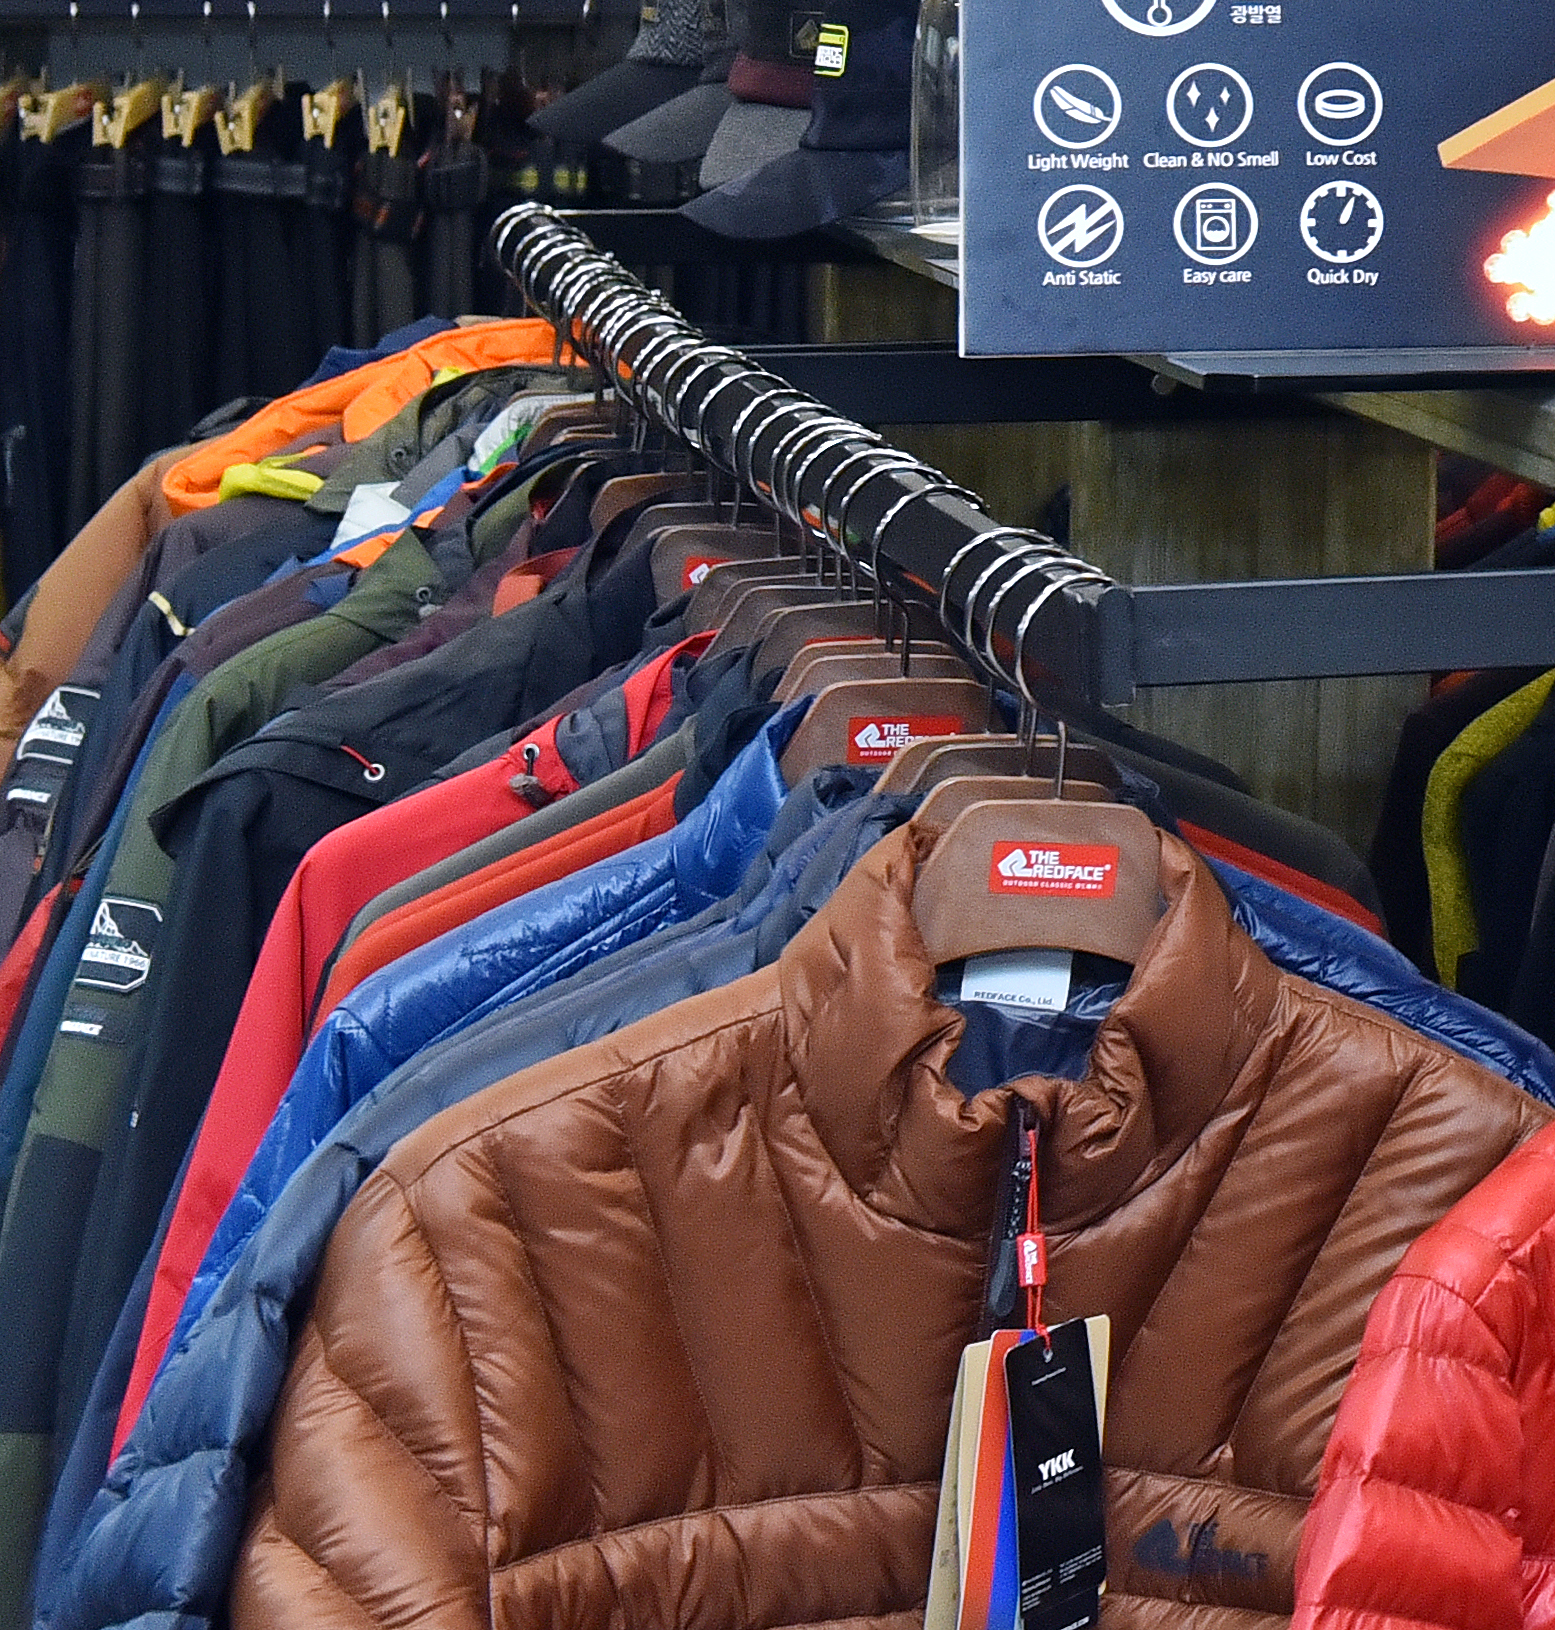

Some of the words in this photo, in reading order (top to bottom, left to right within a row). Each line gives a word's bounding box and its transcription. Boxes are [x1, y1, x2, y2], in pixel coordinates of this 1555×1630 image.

[1229, 4, 1282, 25] 광발열
[1028, 154, 1067, 171] Light
[1068, 154, 1130, 170] Weight
[1143, 152, 1188, 168] Clean
[1191, 153, 1205, 168] &
[1207, 152, 1234, 168] NO
[1237, 151, 1280, 167] Smell
[1306, 151, 1340, 167] Low
[1342, 150, 1378, 166] Cost
[1042, 271, 1076, 286] Anti
[1079, 271, 1122, 286] Static
[1183, 268, 1217, 286] Easy
[1219, 269, 1252, 283] care
[1307, 268, 1350, 285] Quick
[1353, 268, 1379, 286] Dry
[881, 723, 910, 736] THE
[1029, 849, 1061, 865] THE
[1031, 864, 1105, 882] REDFACE
[973, 991, 1017, 1002] REDFACE
[1038, 1448, 1076, 1482] YKK
